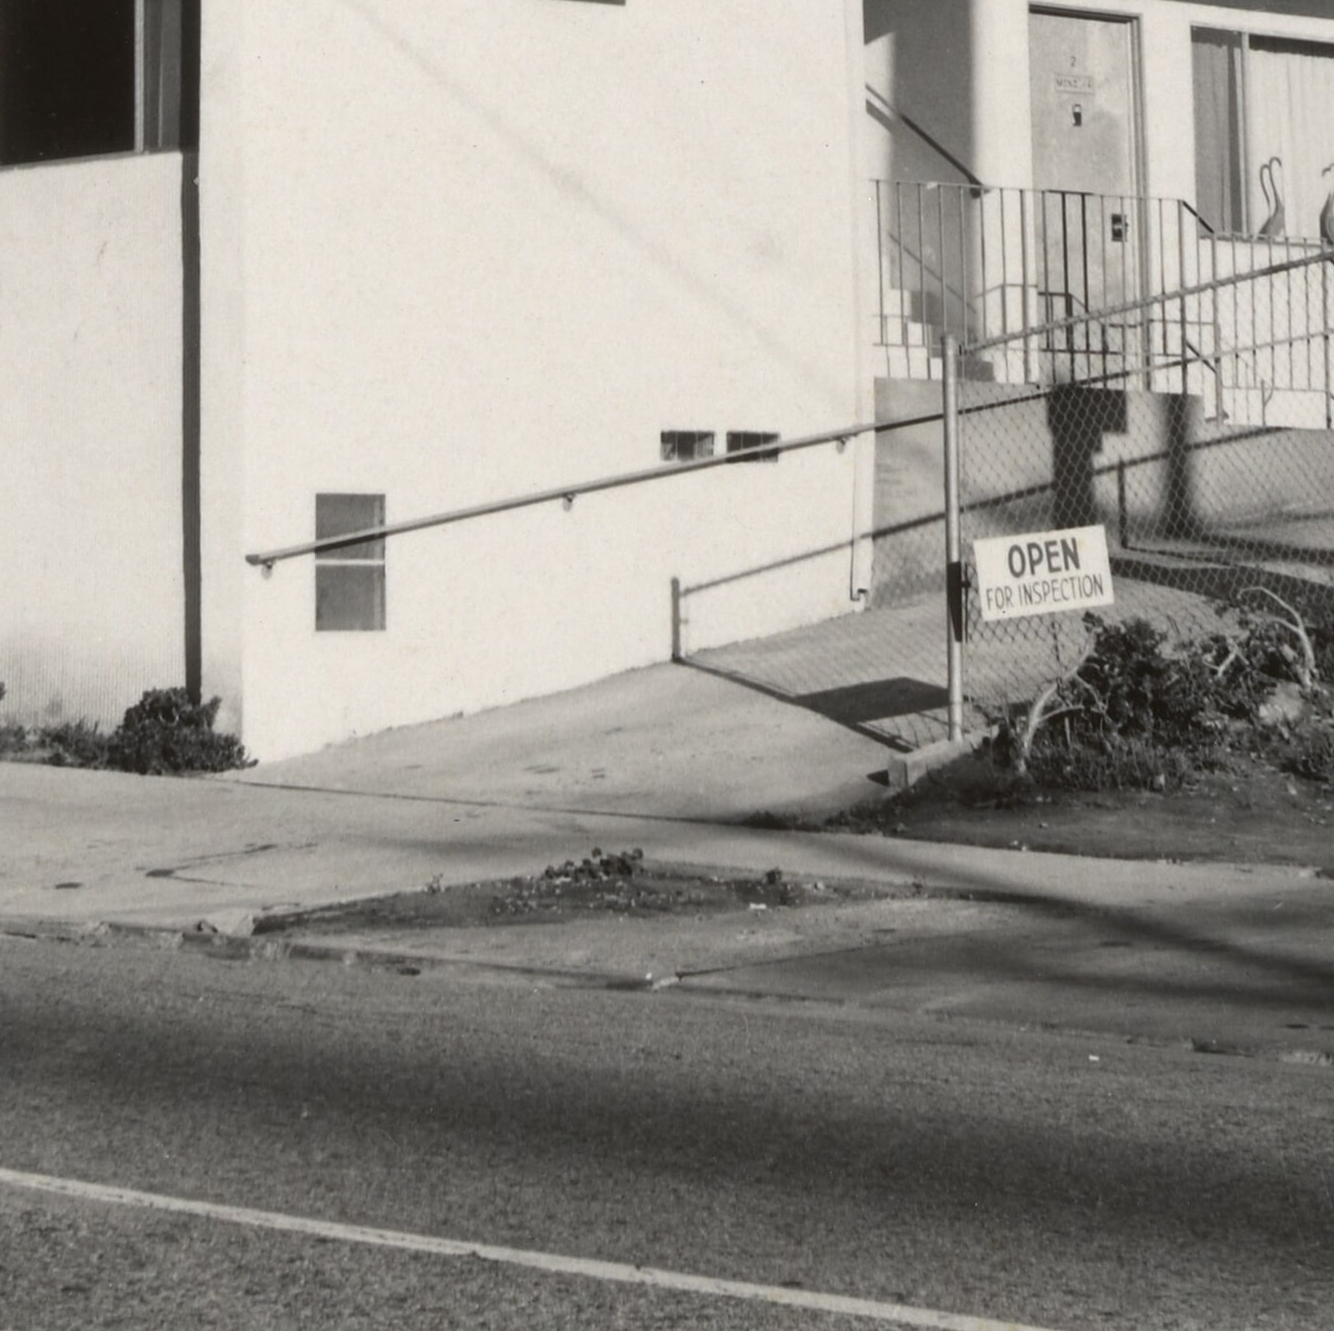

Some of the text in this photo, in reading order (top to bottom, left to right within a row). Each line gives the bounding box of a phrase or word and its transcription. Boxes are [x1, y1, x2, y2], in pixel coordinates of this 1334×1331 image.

[1008, 537, 1080, 578] OPEN
[986, 574, 1105, 611] FOR INSPECTION
